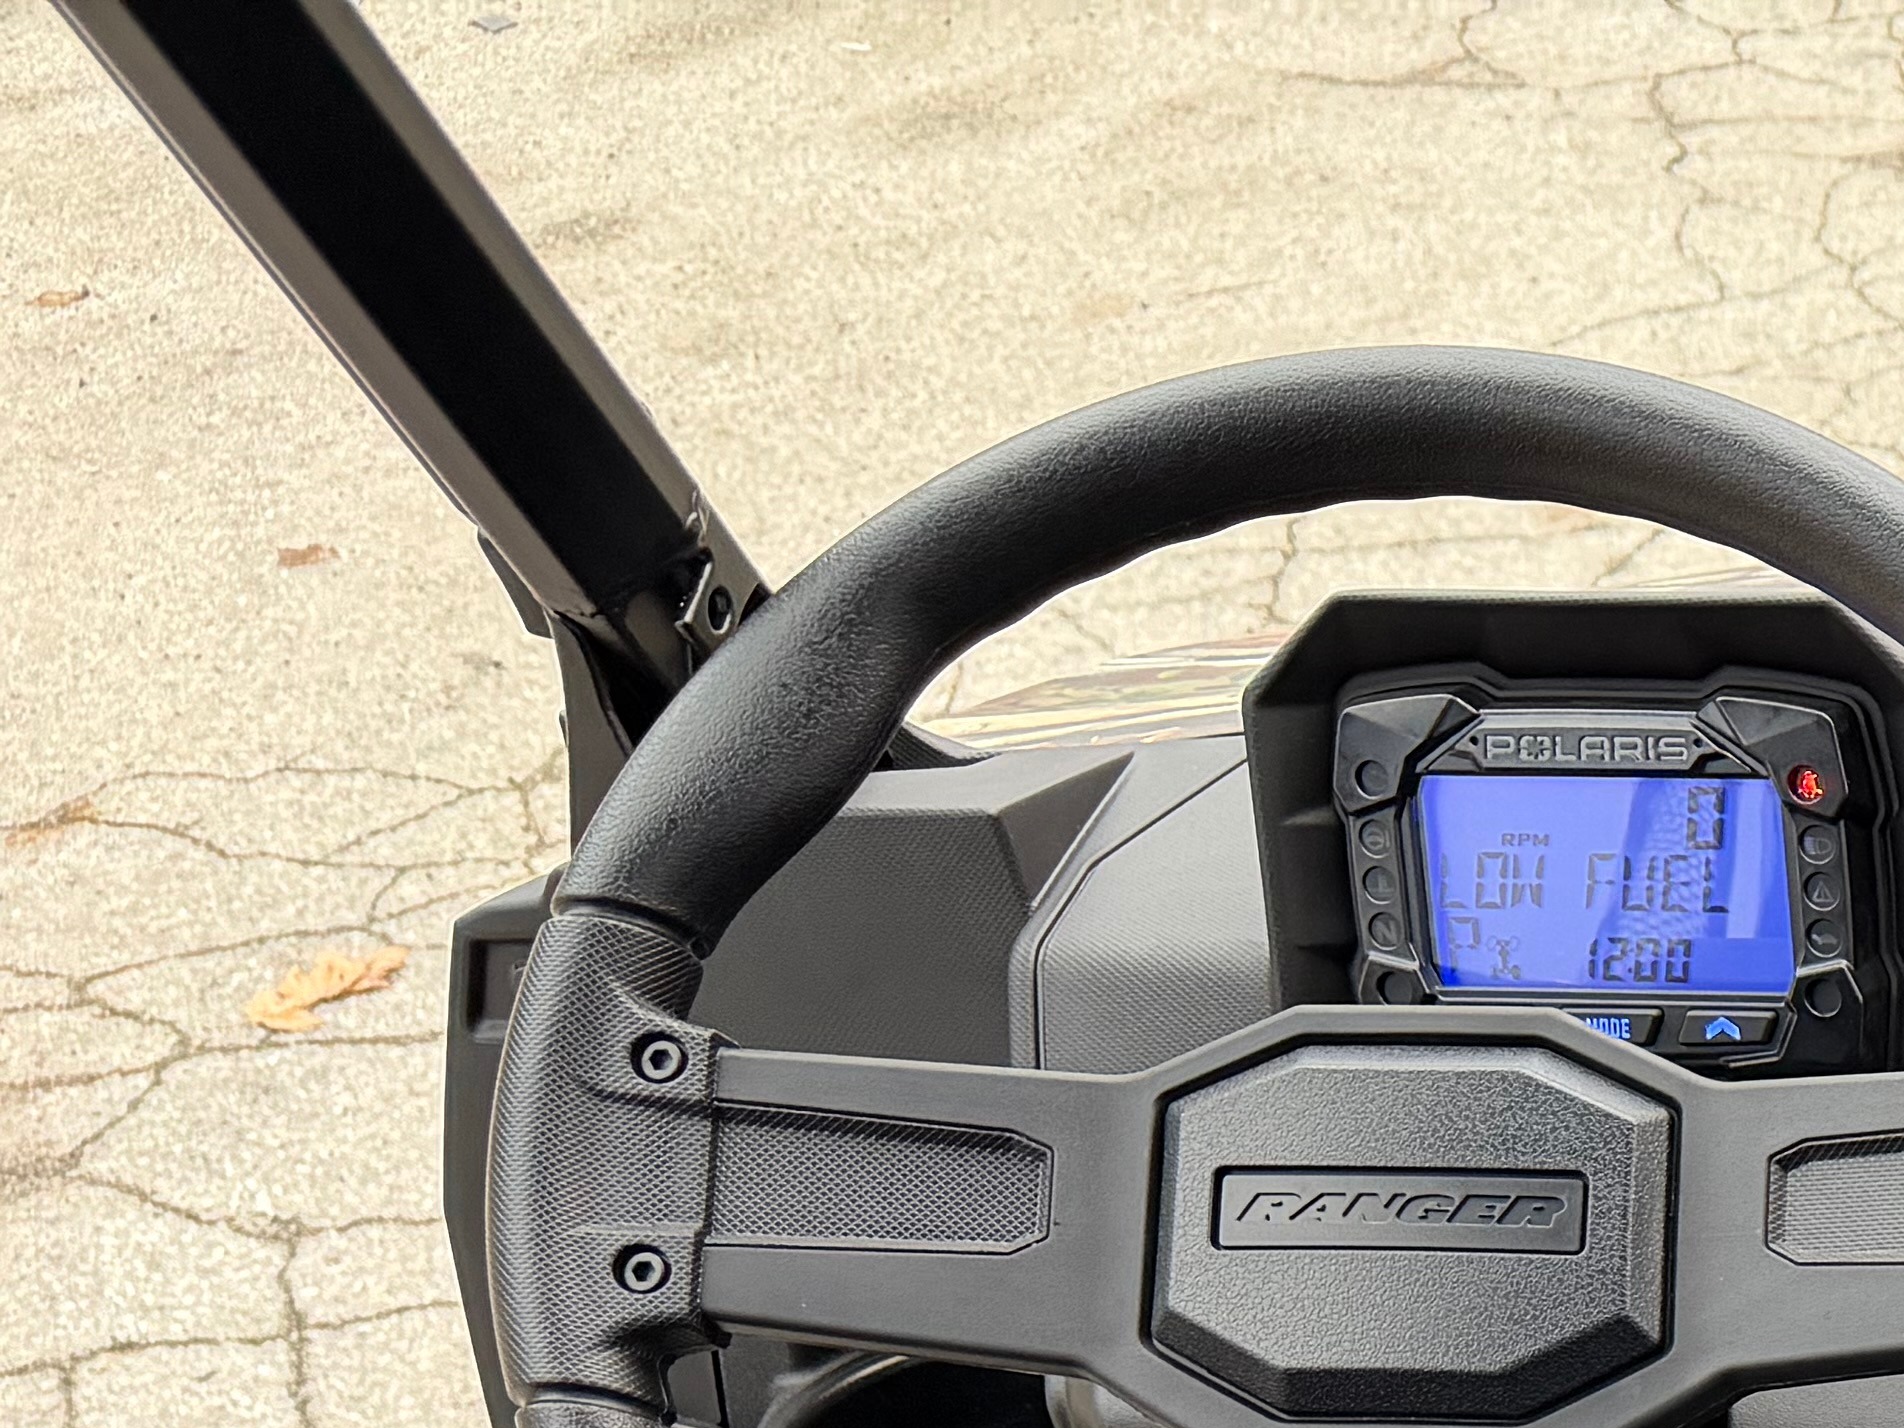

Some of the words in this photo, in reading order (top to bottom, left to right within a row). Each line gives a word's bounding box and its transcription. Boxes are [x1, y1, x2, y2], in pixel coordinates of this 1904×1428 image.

[1484, 734, 1688, 762] POLARIS
[1501, 832, 1550, 847] RPM
[1440, 851, 1545, 909] LOW
[1585, 852, 1730, 913] FUEL
[1235, 1191, 1568, 1228] RANGER
